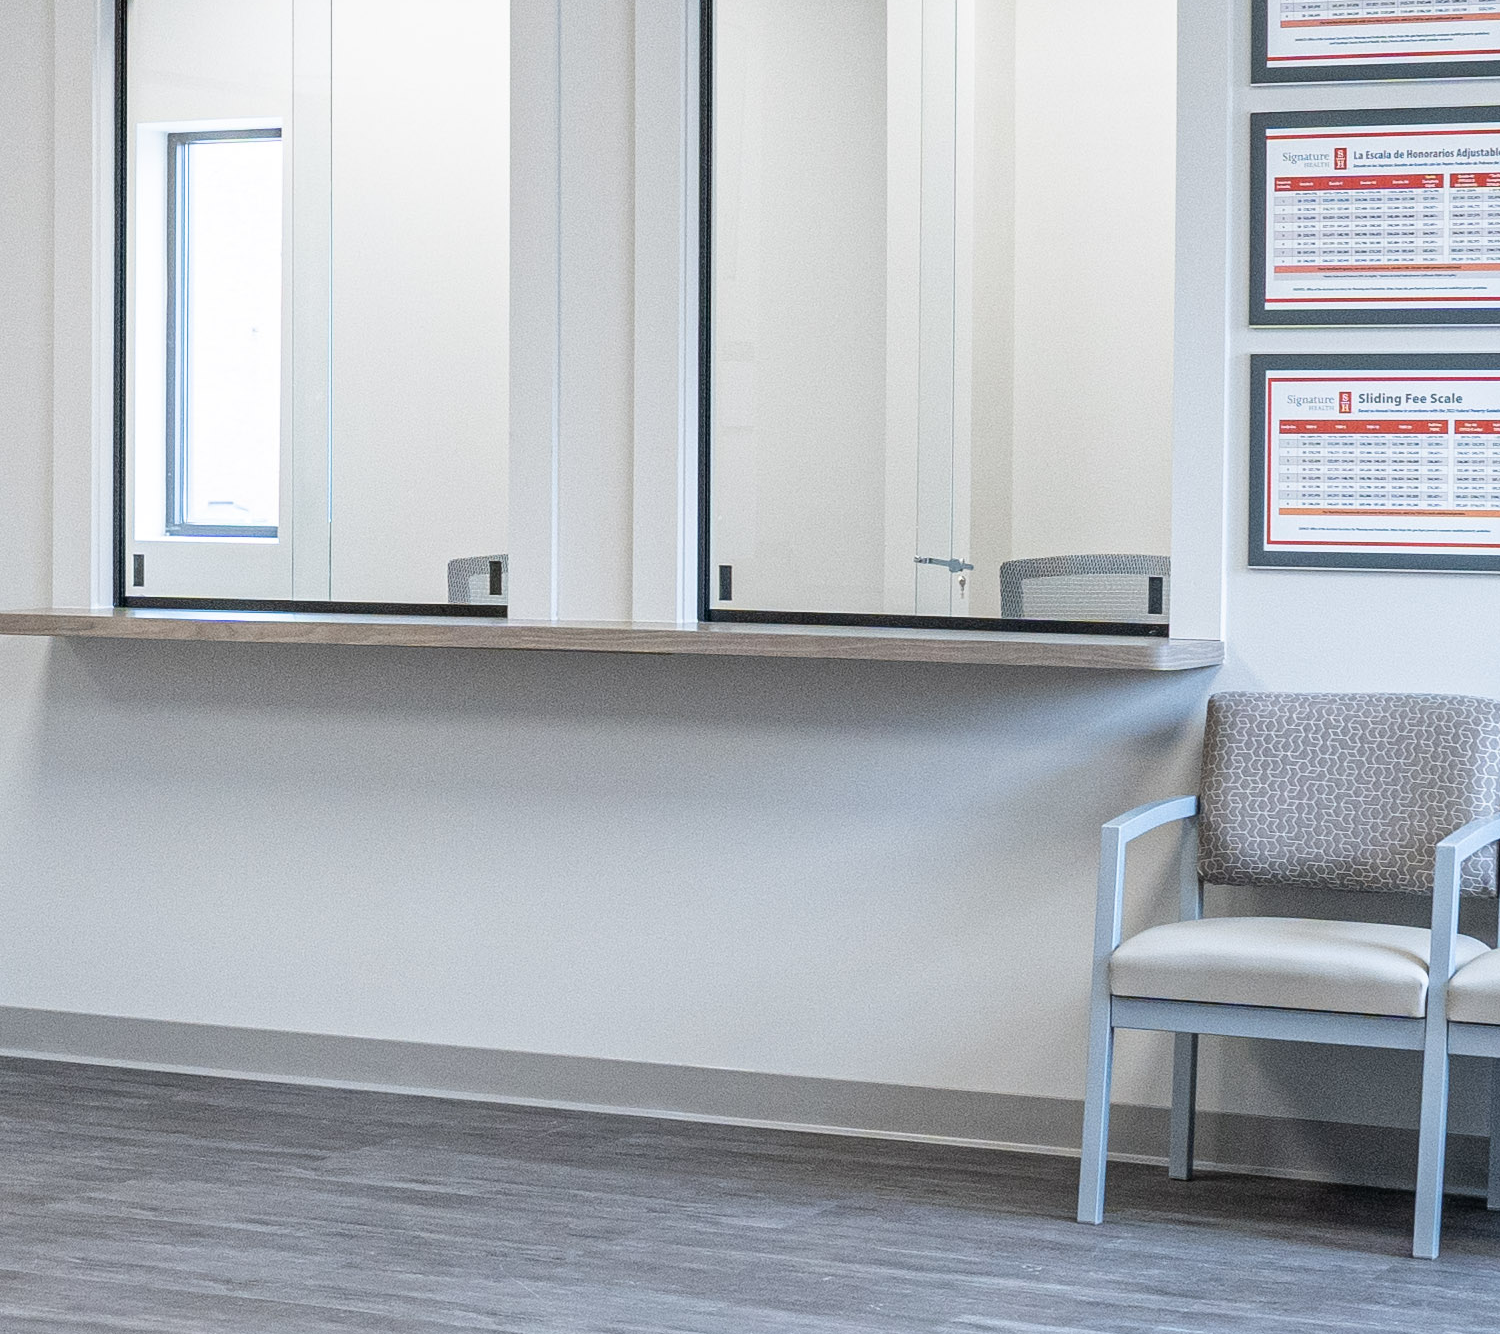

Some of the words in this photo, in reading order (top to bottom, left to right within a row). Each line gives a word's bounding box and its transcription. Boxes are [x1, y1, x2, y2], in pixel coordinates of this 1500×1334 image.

[1282, 152, 1330, 164] Signature
[1353, 151, 1363, 160] La
[1365, 149, 1392, 160] Escala
[1393, 150, 1404, 159] de
[1406, 148, 1454, 159] Honorarios
[1287, 394, 1335, 407] Signature
[1358, 393, 1402, 406] Sliding
[1405, 393, 1427, 404] Fee
[1430, 393, 1463, 404] Scale
